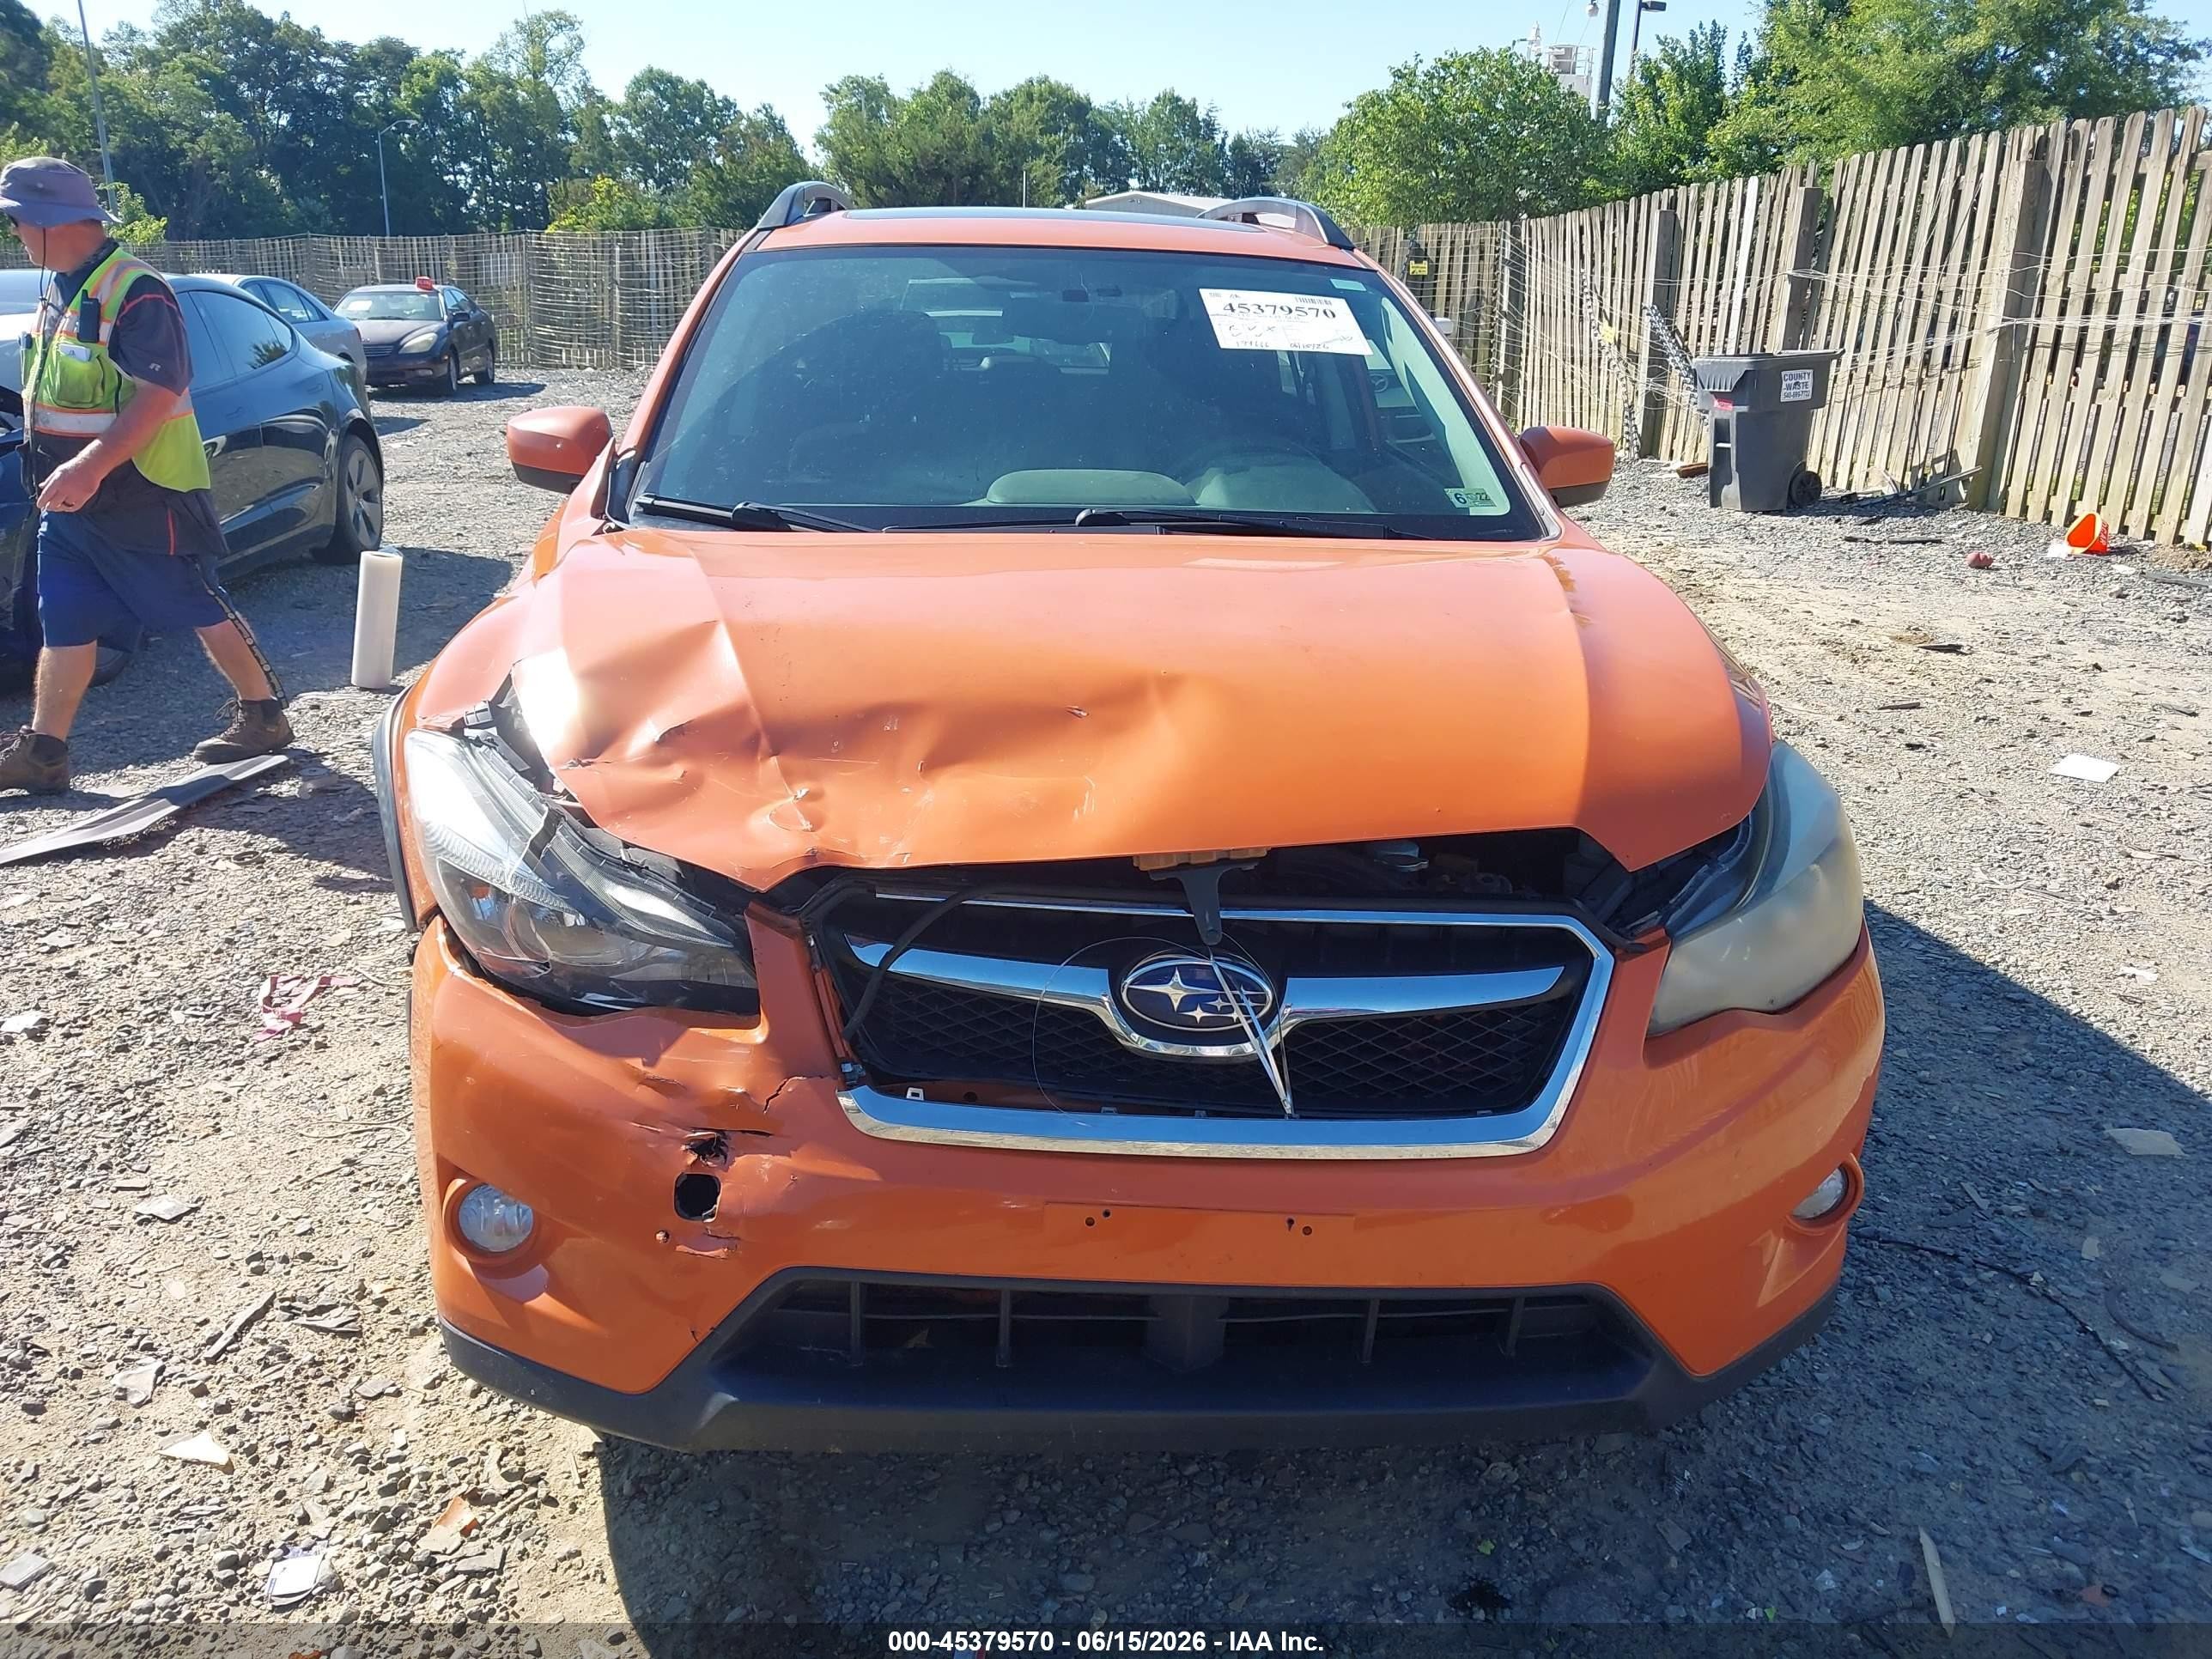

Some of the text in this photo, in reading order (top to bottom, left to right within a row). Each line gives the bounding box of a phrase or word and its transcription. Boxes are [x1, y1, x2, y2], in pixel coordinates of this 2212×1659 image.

[1223, 302, 1336, 319] 45379570
[1784, 372, 1811, 382] COUNTY
[1785, 380, 1809, 391] WASTE
[1454, 493, 1467, 504] 6
